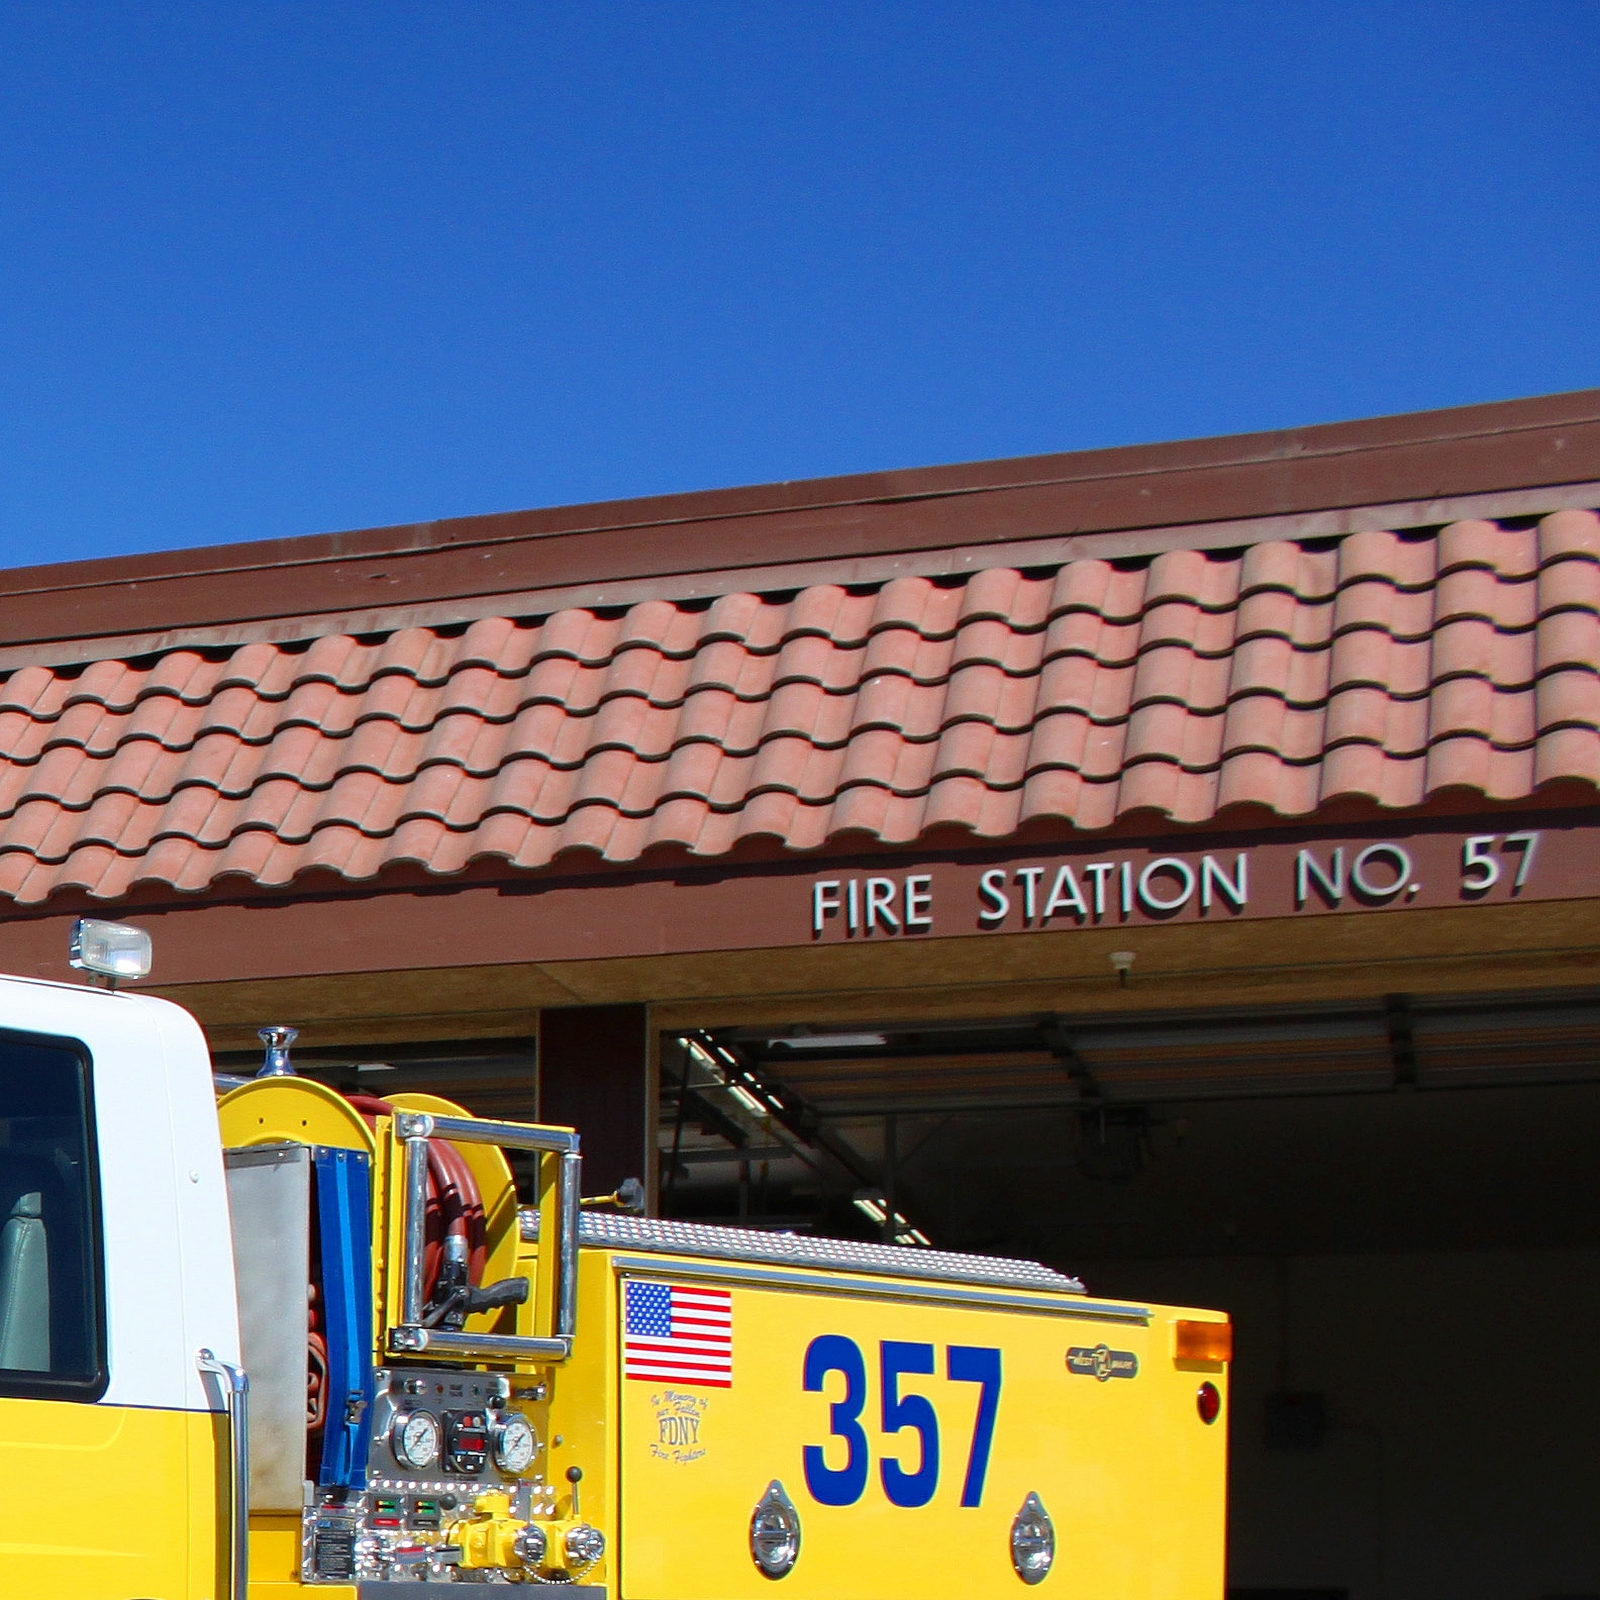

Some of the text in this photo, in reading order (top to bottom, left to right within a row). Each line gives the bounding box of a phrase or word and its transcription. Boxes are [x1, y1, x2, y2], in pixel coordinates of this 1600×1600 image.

[813, 832, 1541, 932] FIRE STATION NO. 57
[664, 1390, 697, 1405] Memory
[659, 1416, 700, 1445] FDNY
[803, 1334, 1002, 1508] 357
[650, 1444, 669, 1460] Fire
